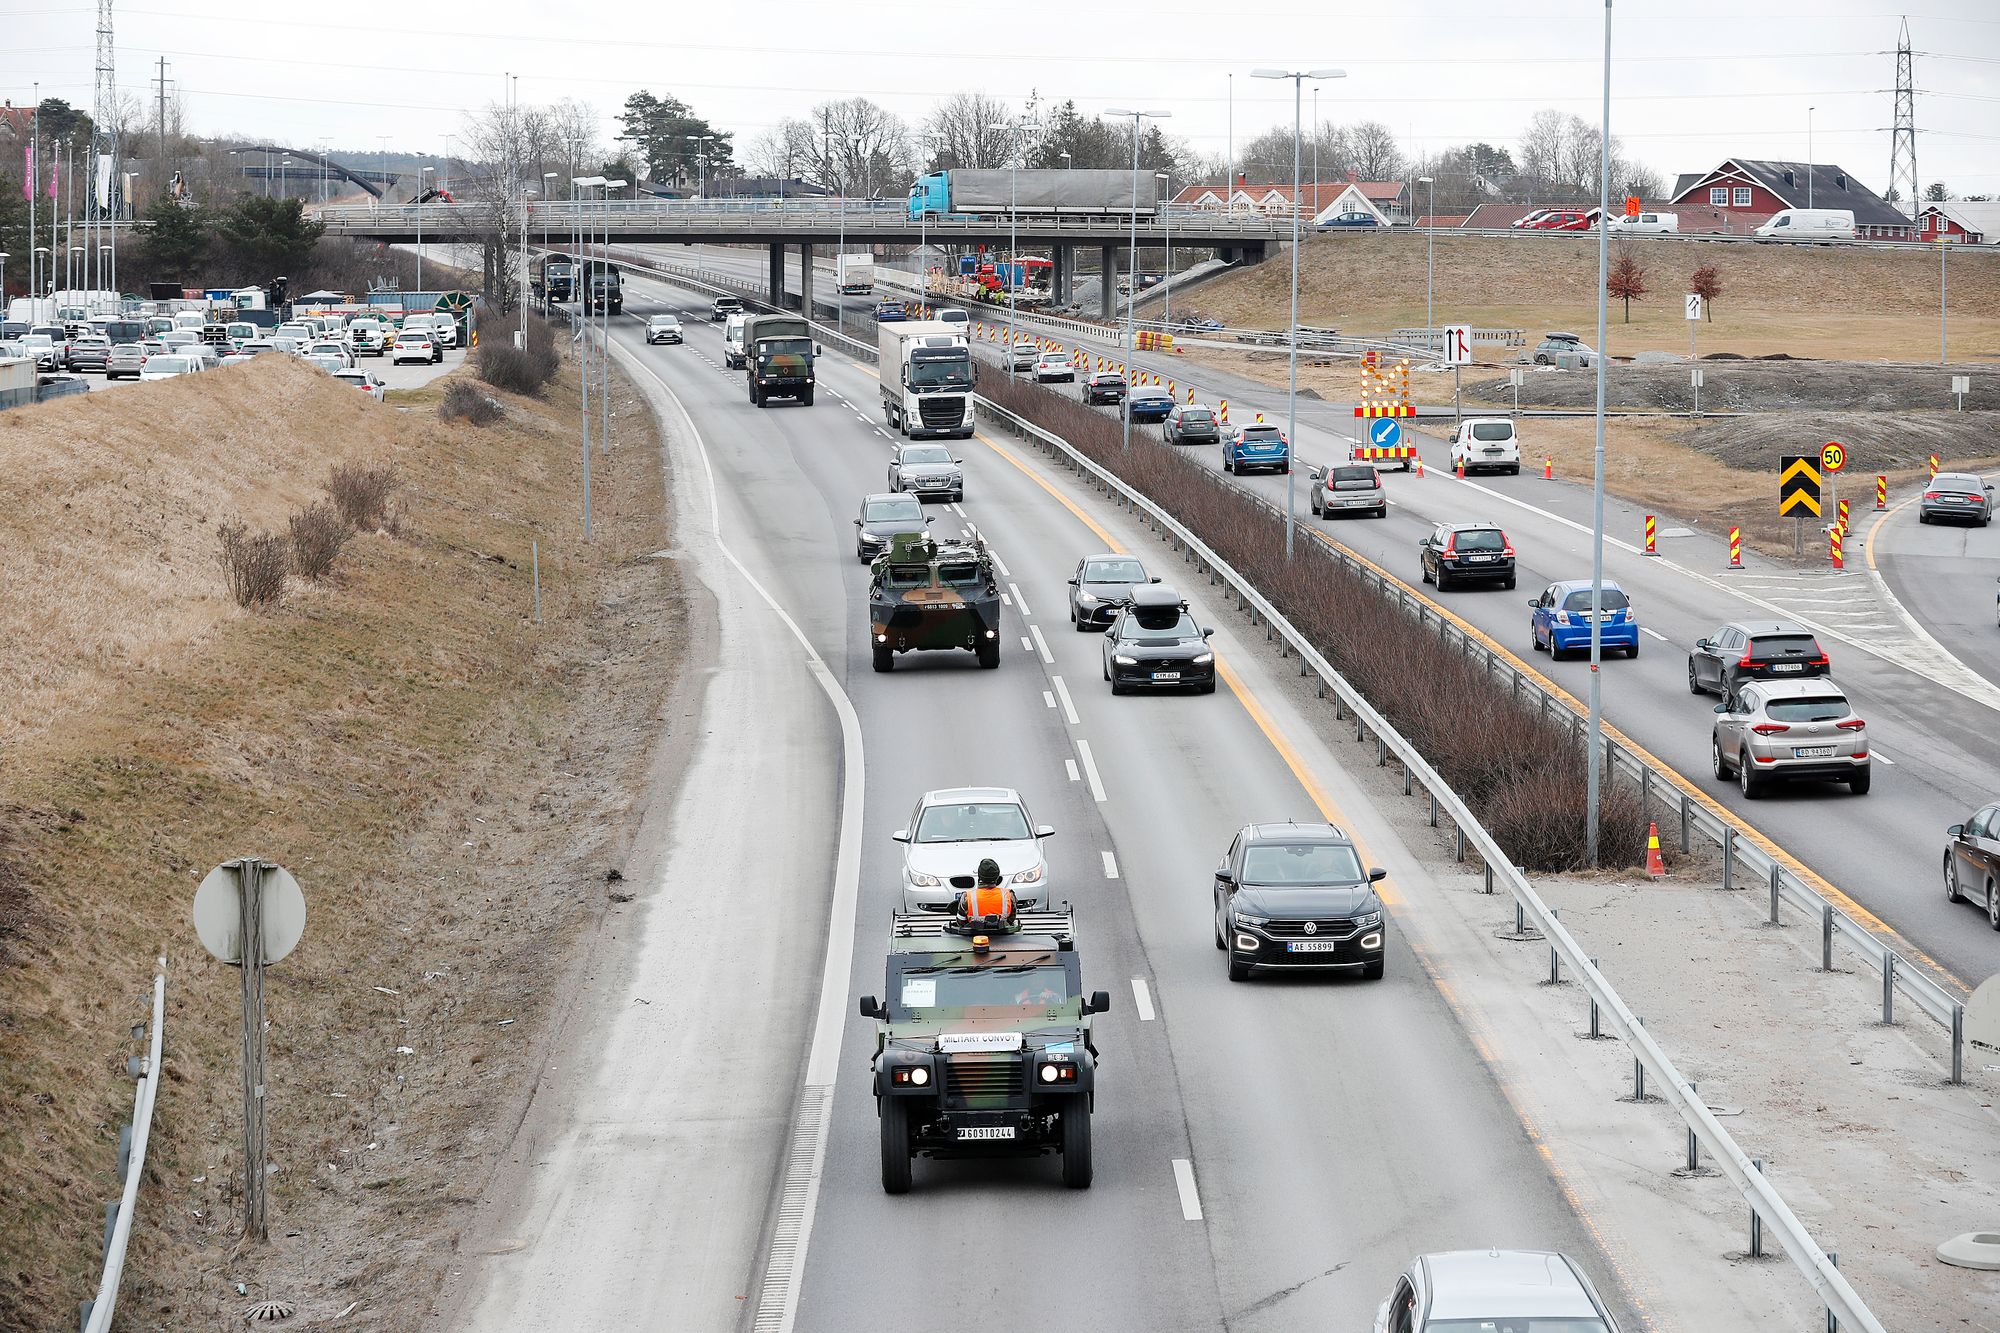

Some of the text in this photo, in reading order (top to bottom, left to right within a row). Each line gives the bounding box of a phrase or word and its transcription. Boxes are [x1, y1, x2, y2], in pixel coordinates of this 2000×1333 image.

[1825, 450, 1841, 464] 50
[1308, 942, 1332, 950] 55899
[944, 1034, 1016, 1044] MILITARY CONVOY
[967, 1128, 1011, 1138] 60910244
